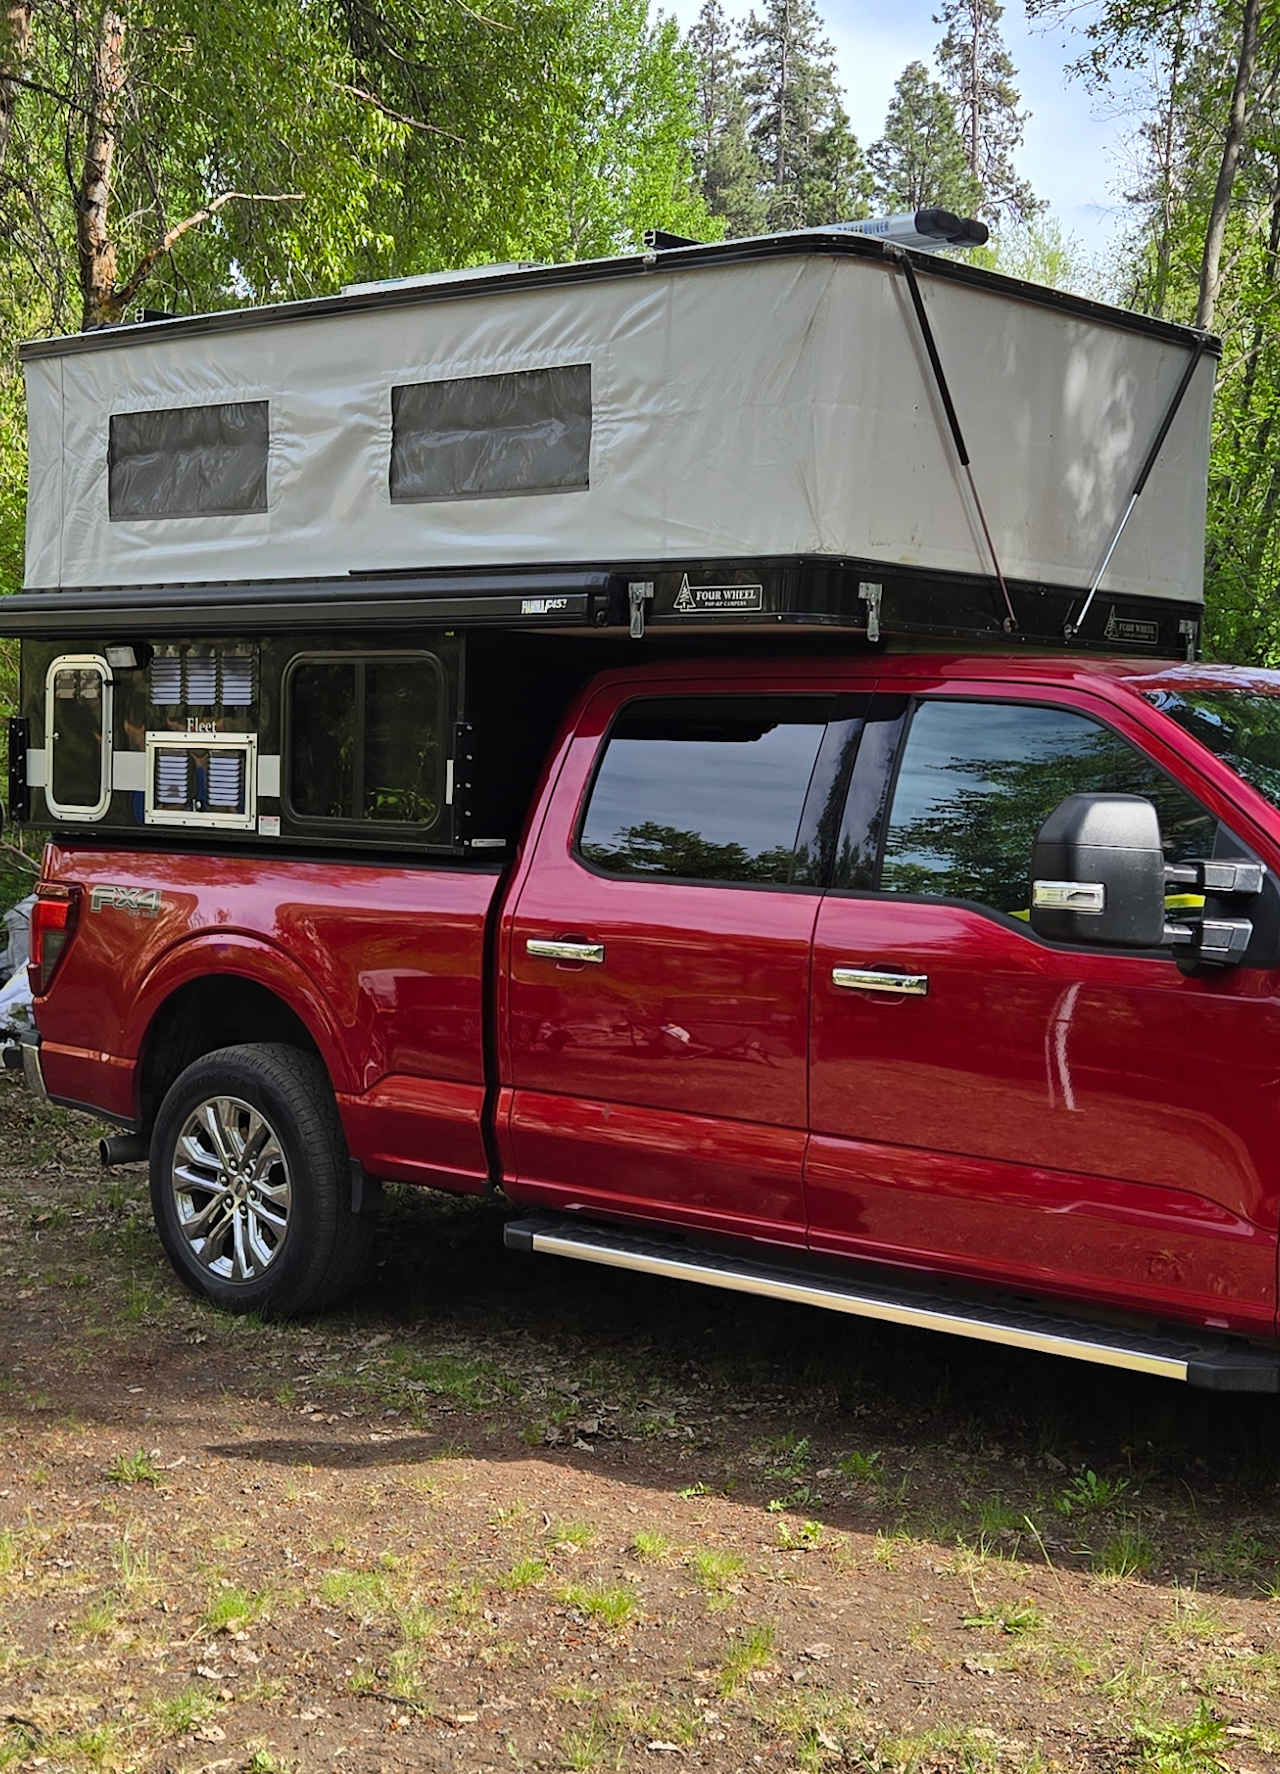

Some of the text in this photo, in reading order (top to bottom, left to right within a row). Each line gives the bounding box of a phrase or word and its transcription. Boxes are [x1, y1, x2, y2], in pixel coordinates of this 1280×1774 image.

[696, 589, 756, 601] FOUR WHEEL
[186, 717, 217, 732] Fleet
[91, 885, 161, 913] FX4
